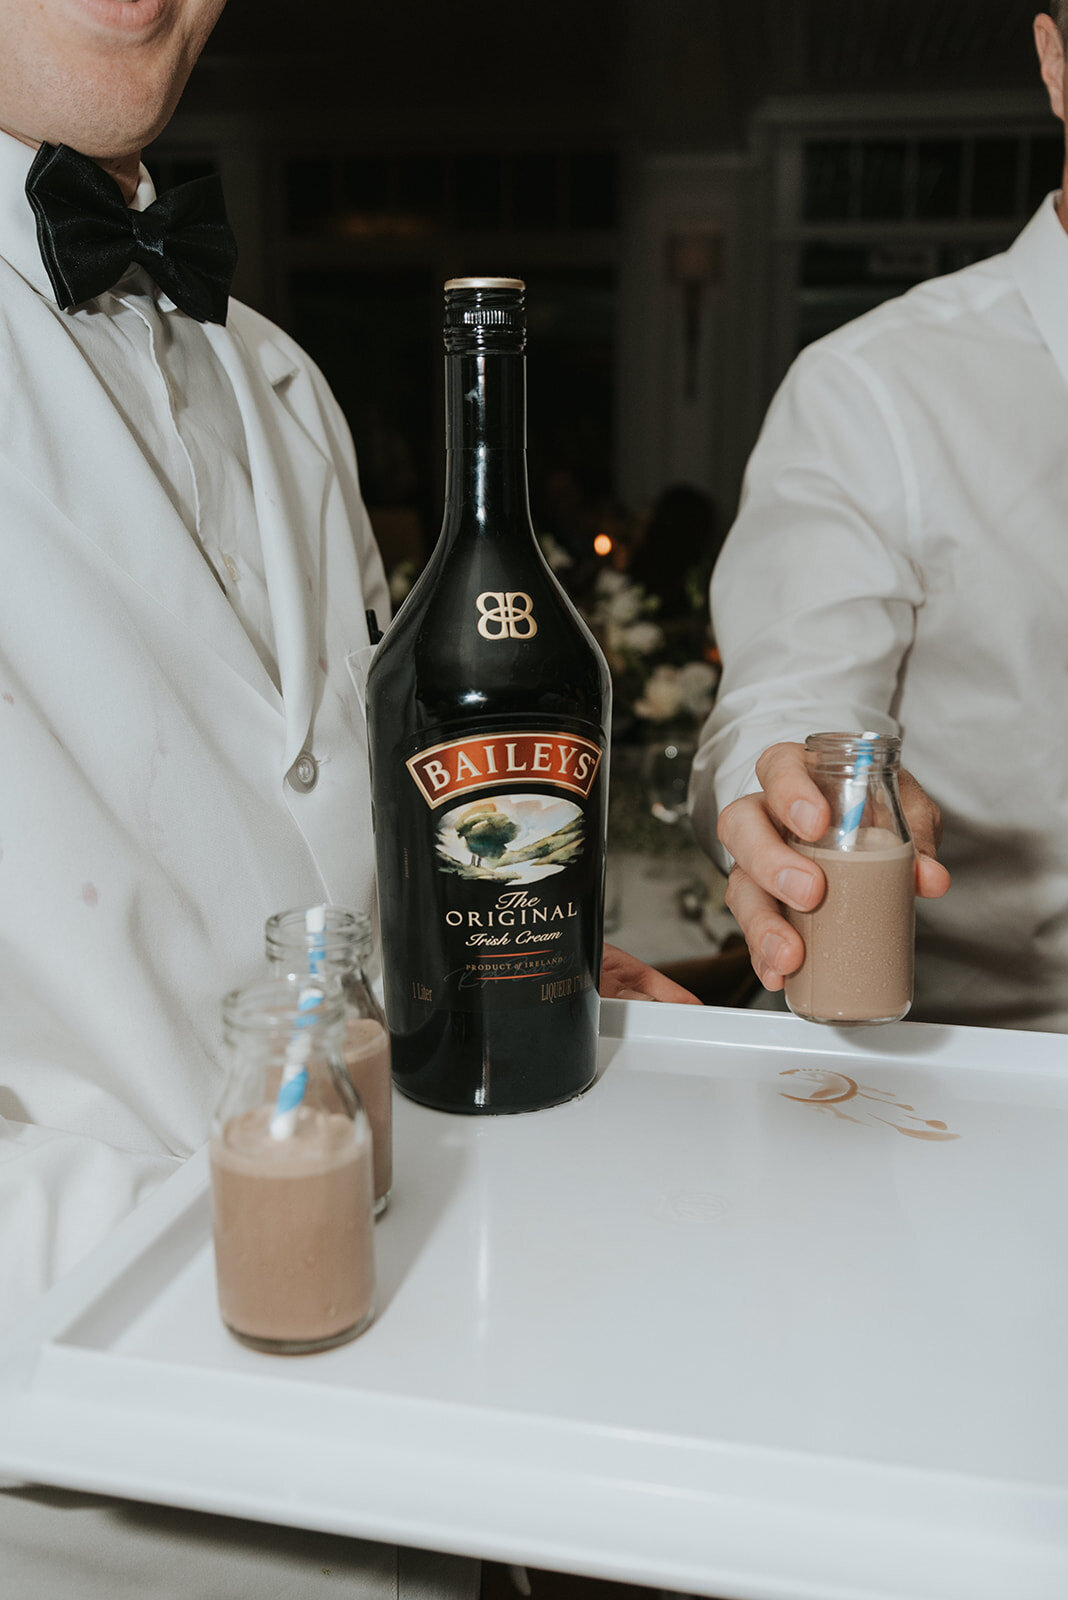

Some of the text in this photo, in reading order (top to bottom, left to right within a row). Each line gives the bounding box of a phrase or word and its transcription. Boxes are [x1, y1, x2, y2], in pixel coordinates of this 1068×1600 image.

[422, 742, 593, 792] BAILEYS
[495, 890, 541, 910] The
[445, 902, 578, 928] ORIGINAL
[465, 930, 563, 947] Irish Cream
[465, 956, 564, 972] PRODUCT of IRELAND
[417, 982, 433, 1002] Liter
[541, 977, 572, 1004] LIQUEUR
